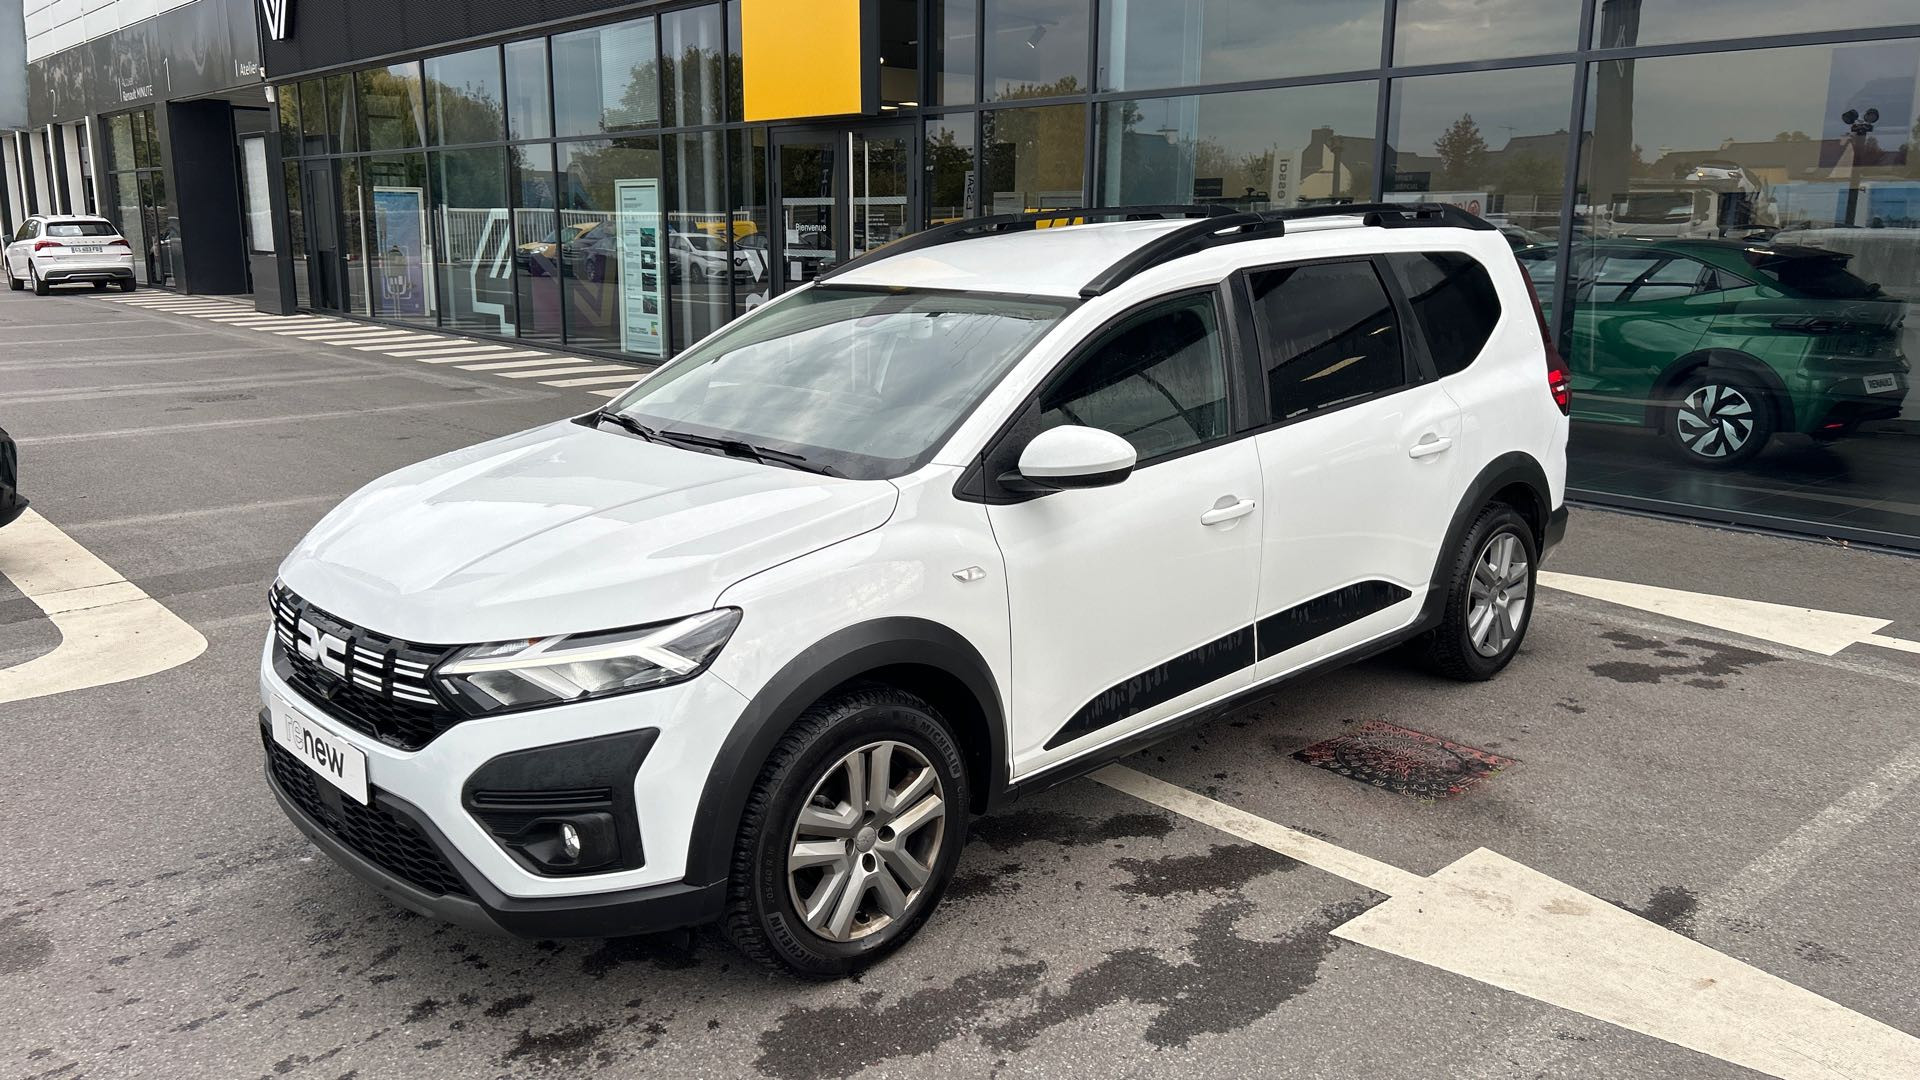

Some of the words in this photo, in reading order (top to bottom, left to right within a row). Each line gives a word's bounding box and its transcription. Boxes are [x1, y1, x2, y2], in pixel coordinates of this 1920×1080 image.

[239, 61, 258, 76] Atelier
[137, 84, 153, 98] MINUTE
[795, 223, 827, 232] Bienvenue
[285, 713, 345, 778] renew
[919, 721, 961, 775] MICHELIN
[769, 915, 821, 967] MICHELIN
